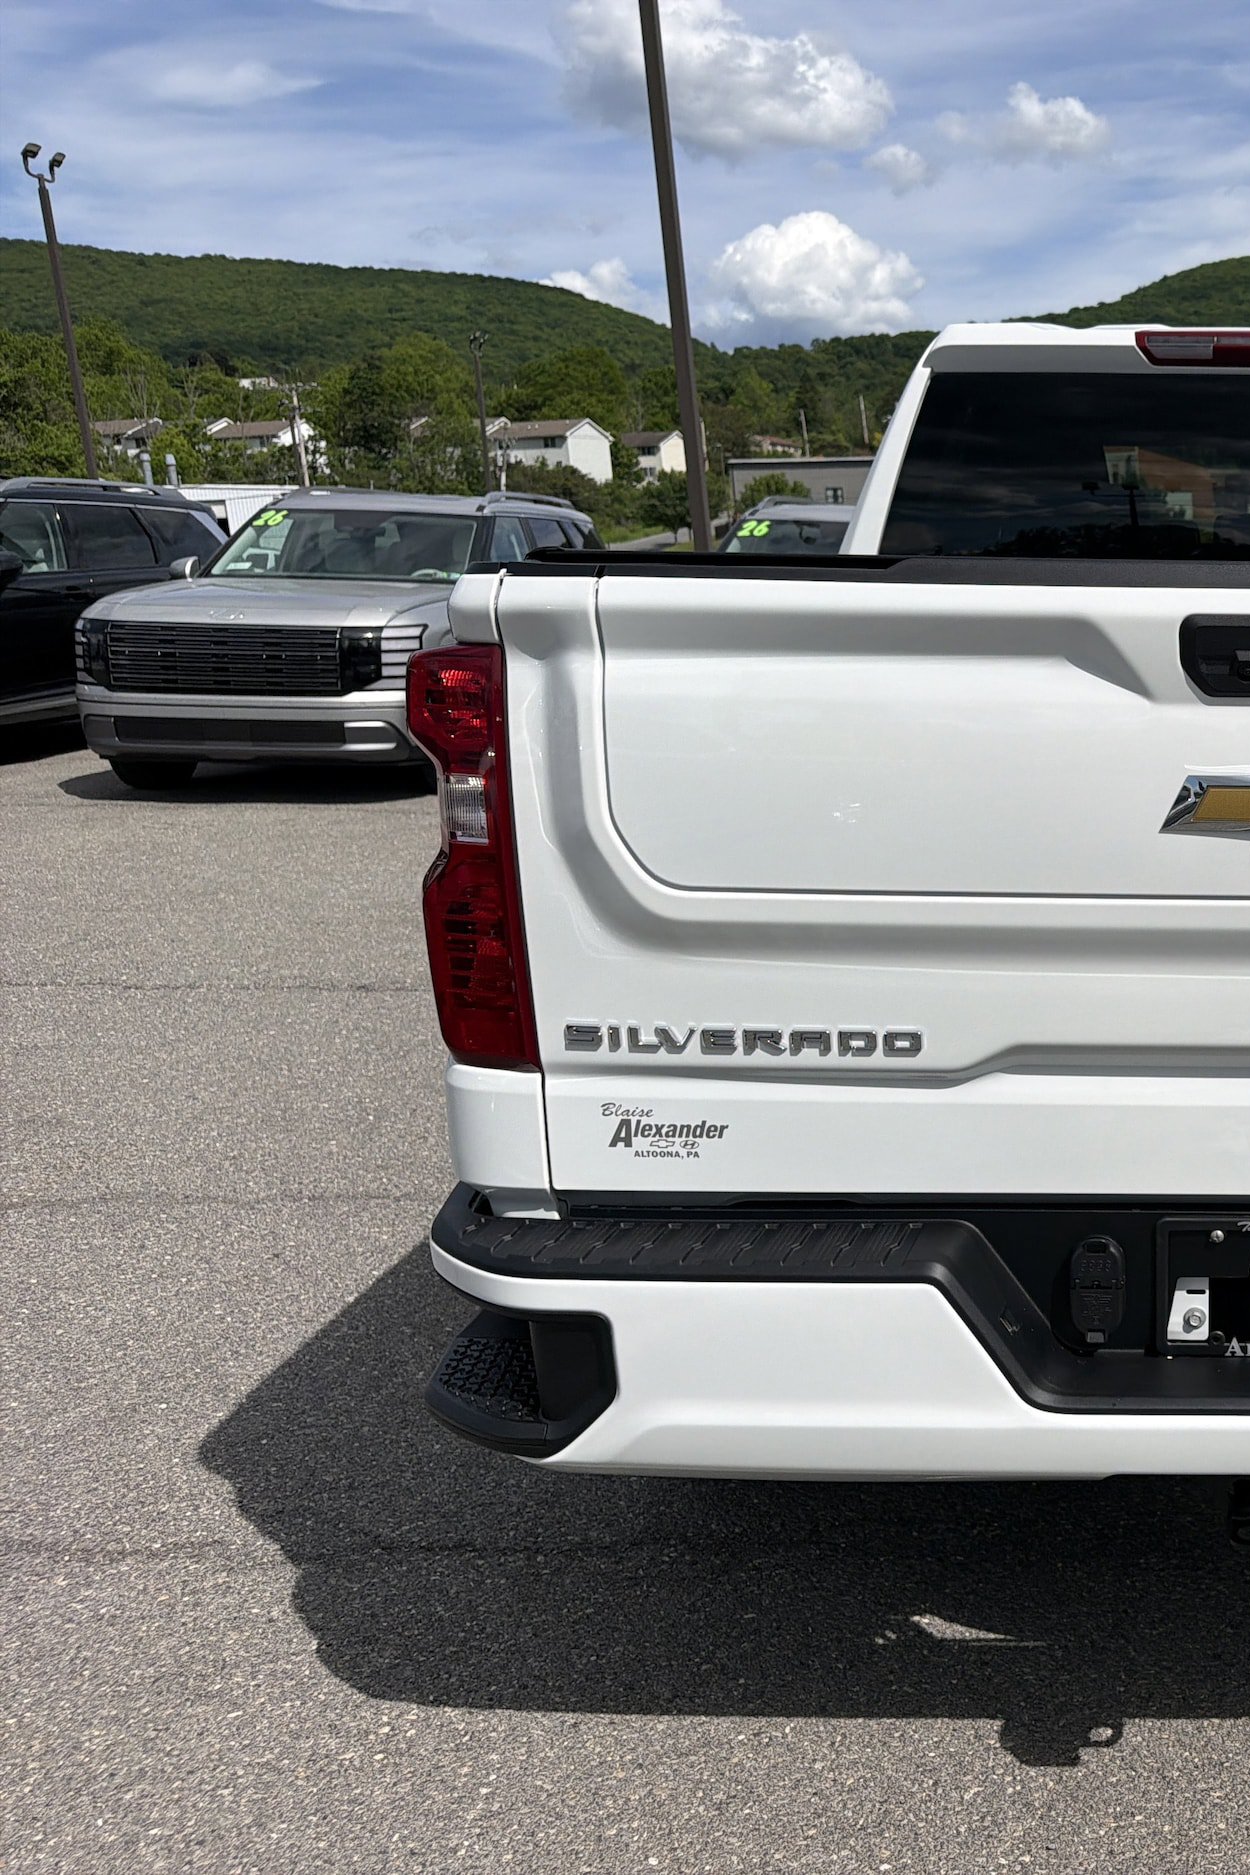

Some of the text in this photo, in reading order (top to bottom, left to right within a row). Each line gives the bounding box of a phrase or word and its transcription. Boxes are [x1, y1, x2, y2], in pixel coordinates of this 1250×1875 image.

[252, 509, 289, 526] 26
[736, 520, 772, 537] 26
[563, 1023, 924, 1057] SILVERADO
[600, 1102, 654, 1118] Blaise
[608, 1118, 729, 1148] Alexander
[634, 1150, 700, 1160] ALTOONA, PA
